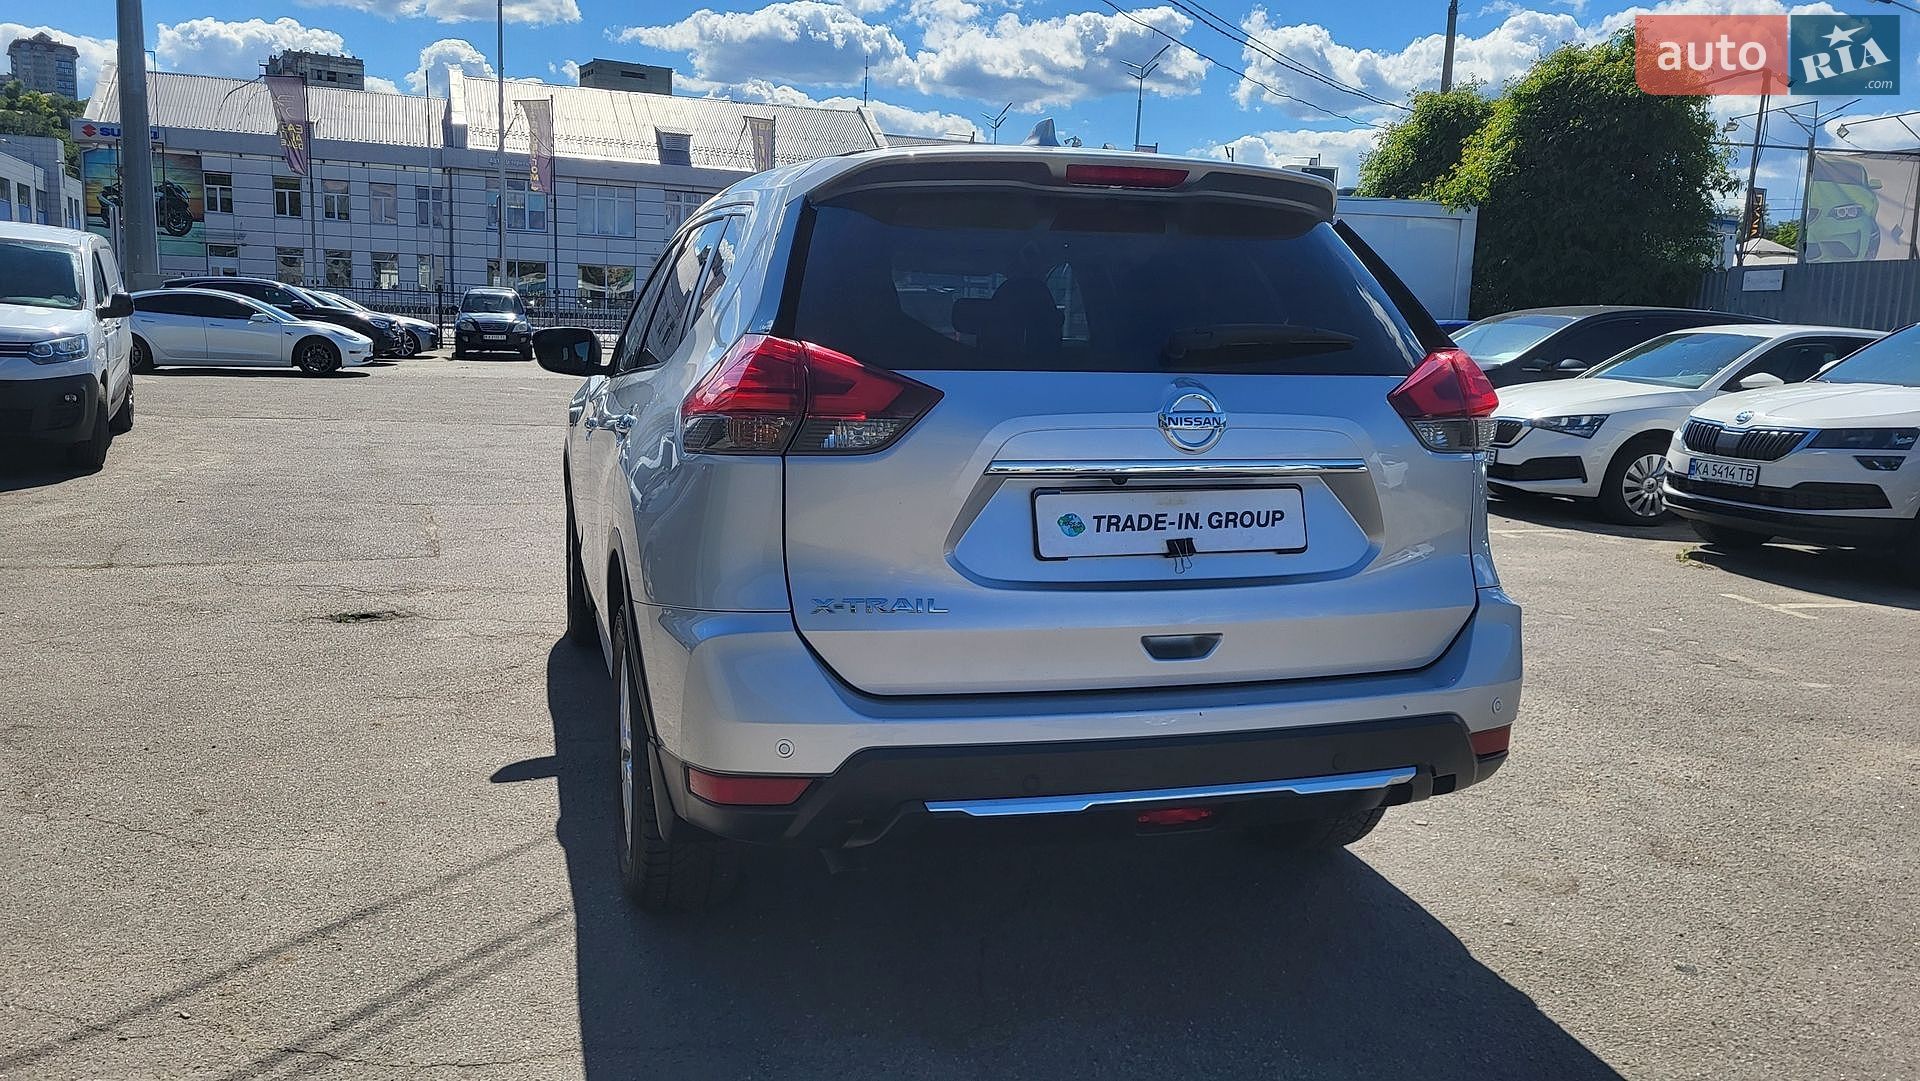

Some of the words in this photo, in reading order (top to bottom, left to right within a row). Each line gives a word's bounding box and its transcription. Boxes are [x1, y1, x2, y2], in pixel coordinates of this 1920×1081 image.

[1167, 416, 1221, 427] NISSAN
[1696, 462, 1709, 476] KA
[1712, 464, 1736, 479] 5414
[1739, 467, 1755, 481] TB
[1207, 510, 1285, 530] GROUP
[810, 597, 950, 614] X-TRAIL
